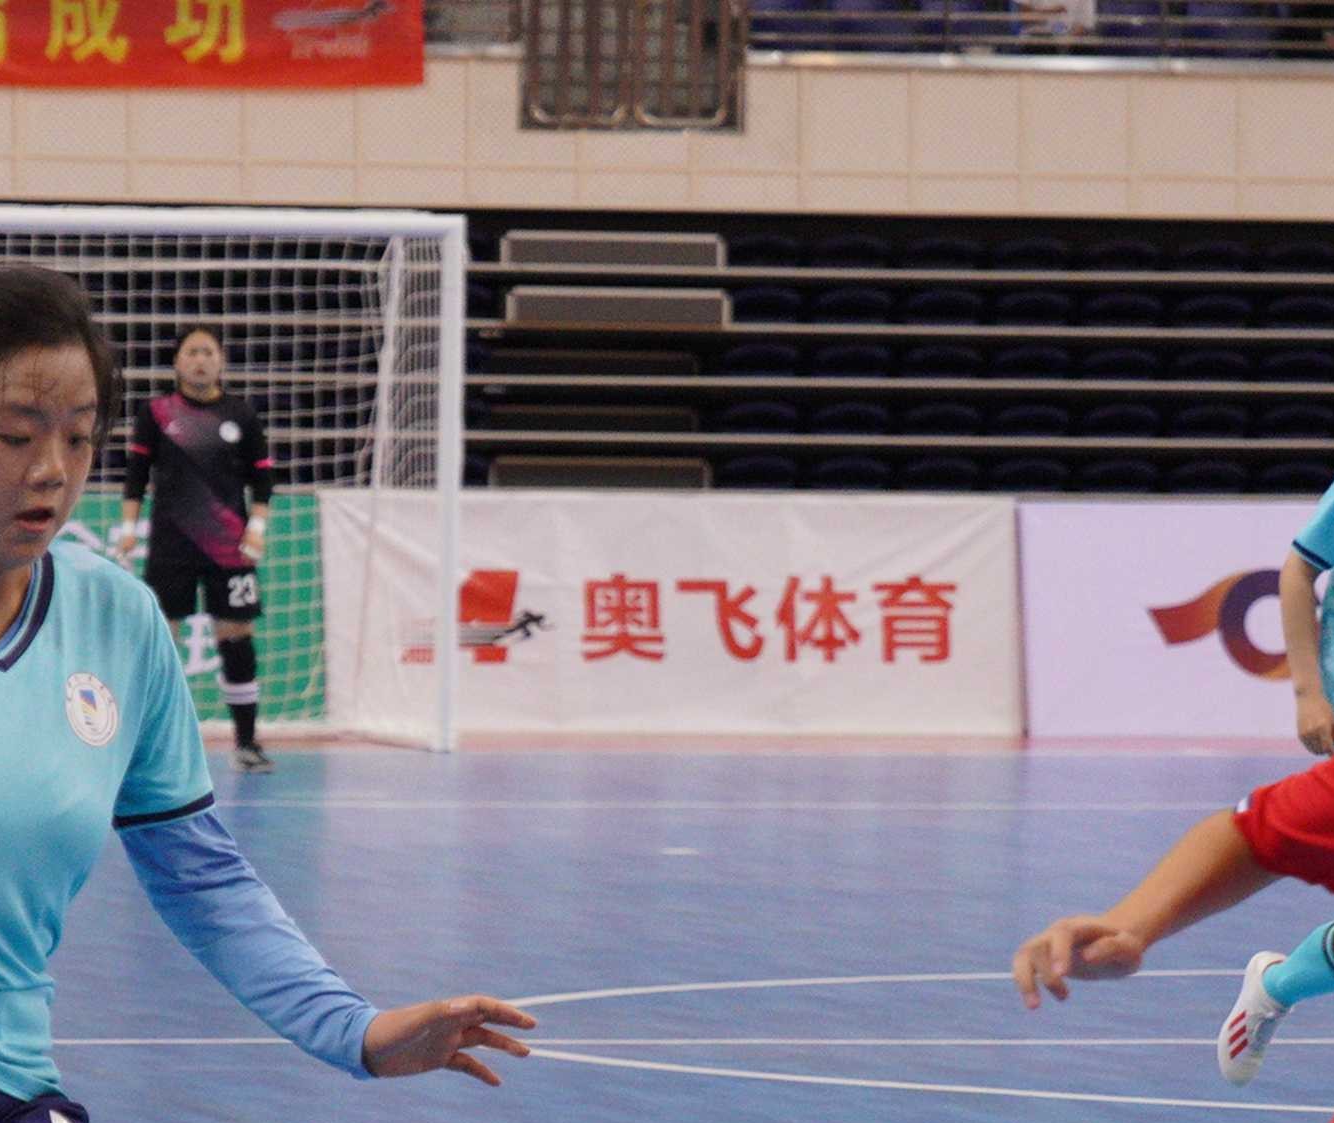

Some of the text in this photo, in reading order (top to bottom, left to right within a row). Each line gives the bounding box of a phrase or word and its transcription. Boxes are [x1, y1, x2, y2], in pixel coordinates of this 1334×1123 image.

[228, 573, 257, 607] 23
[581, 573, 959, 664] 奥飞体育
